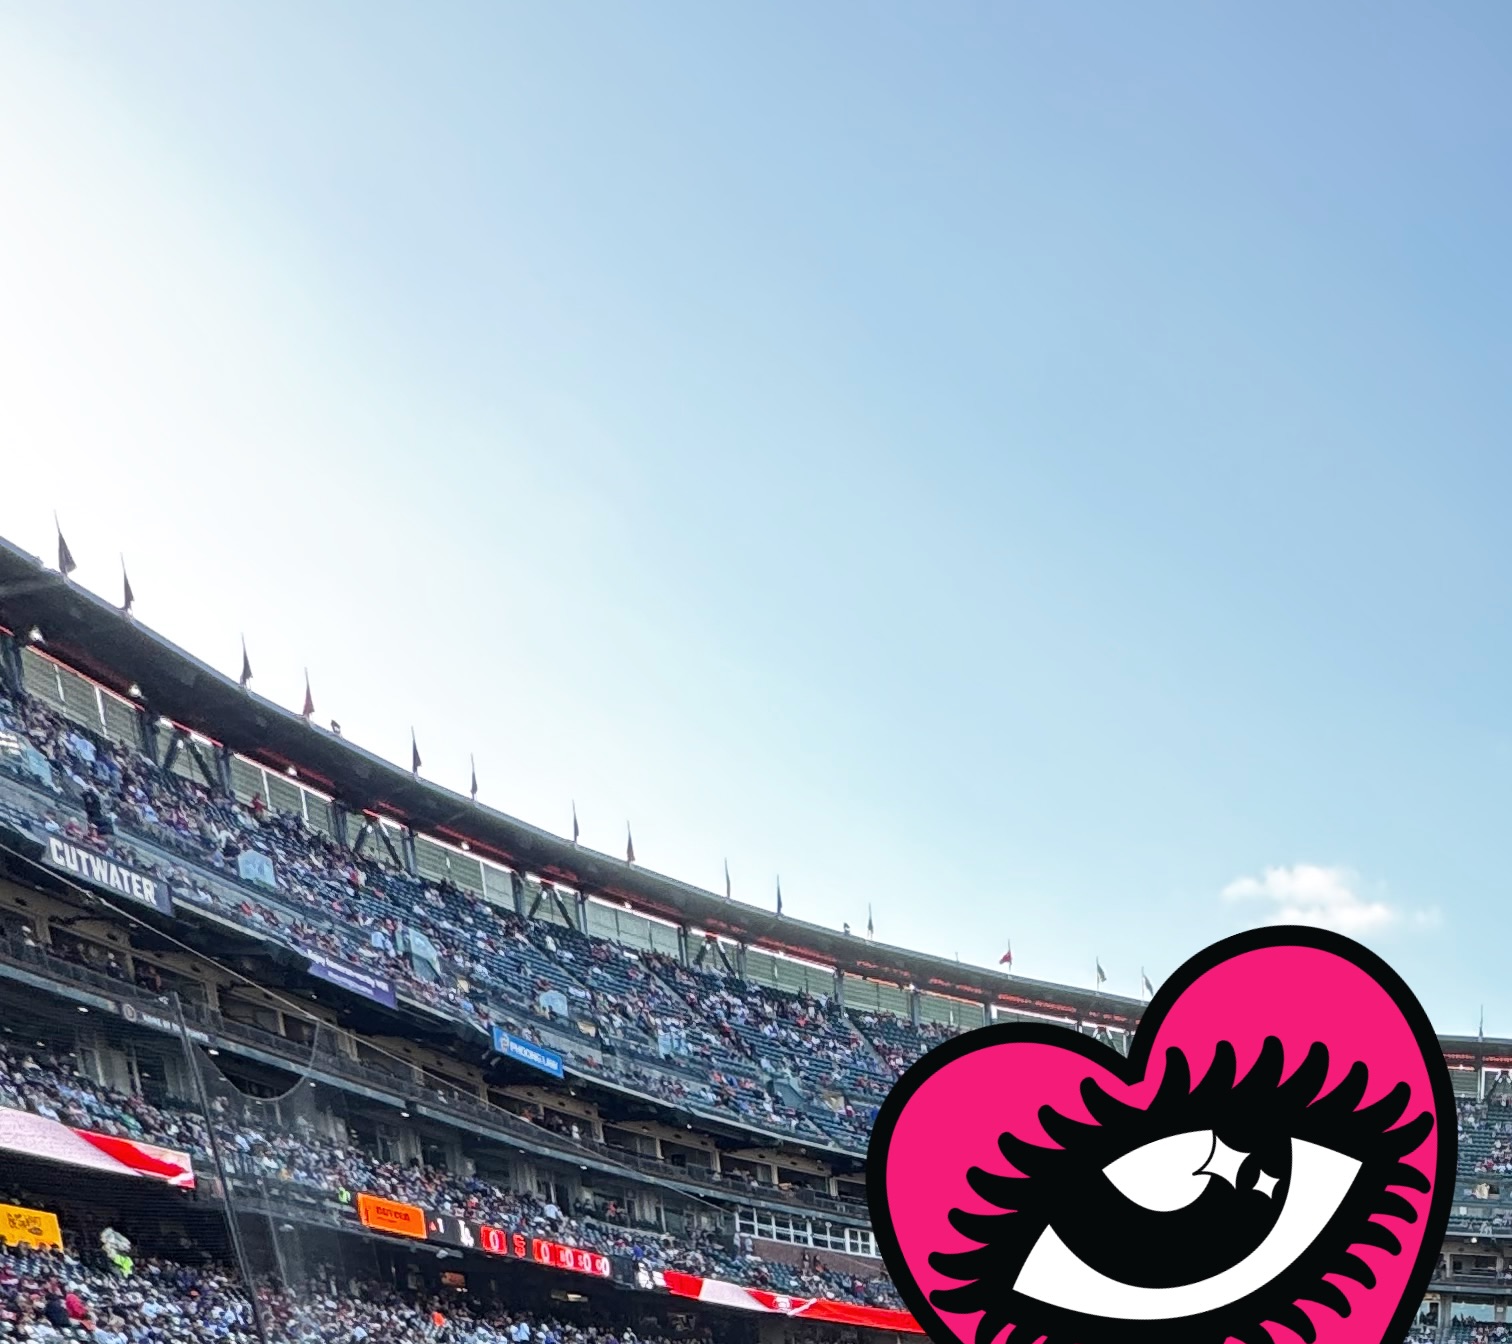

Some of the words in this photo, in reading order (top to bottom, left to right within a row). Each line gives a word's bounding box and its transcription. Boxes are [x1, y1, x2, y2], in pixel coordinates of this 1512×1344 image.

[49, 836, 158, 907] CUTWATER
[489, 1229, 500, 1252] 0
[540, 1243, 551, 1264] 0
